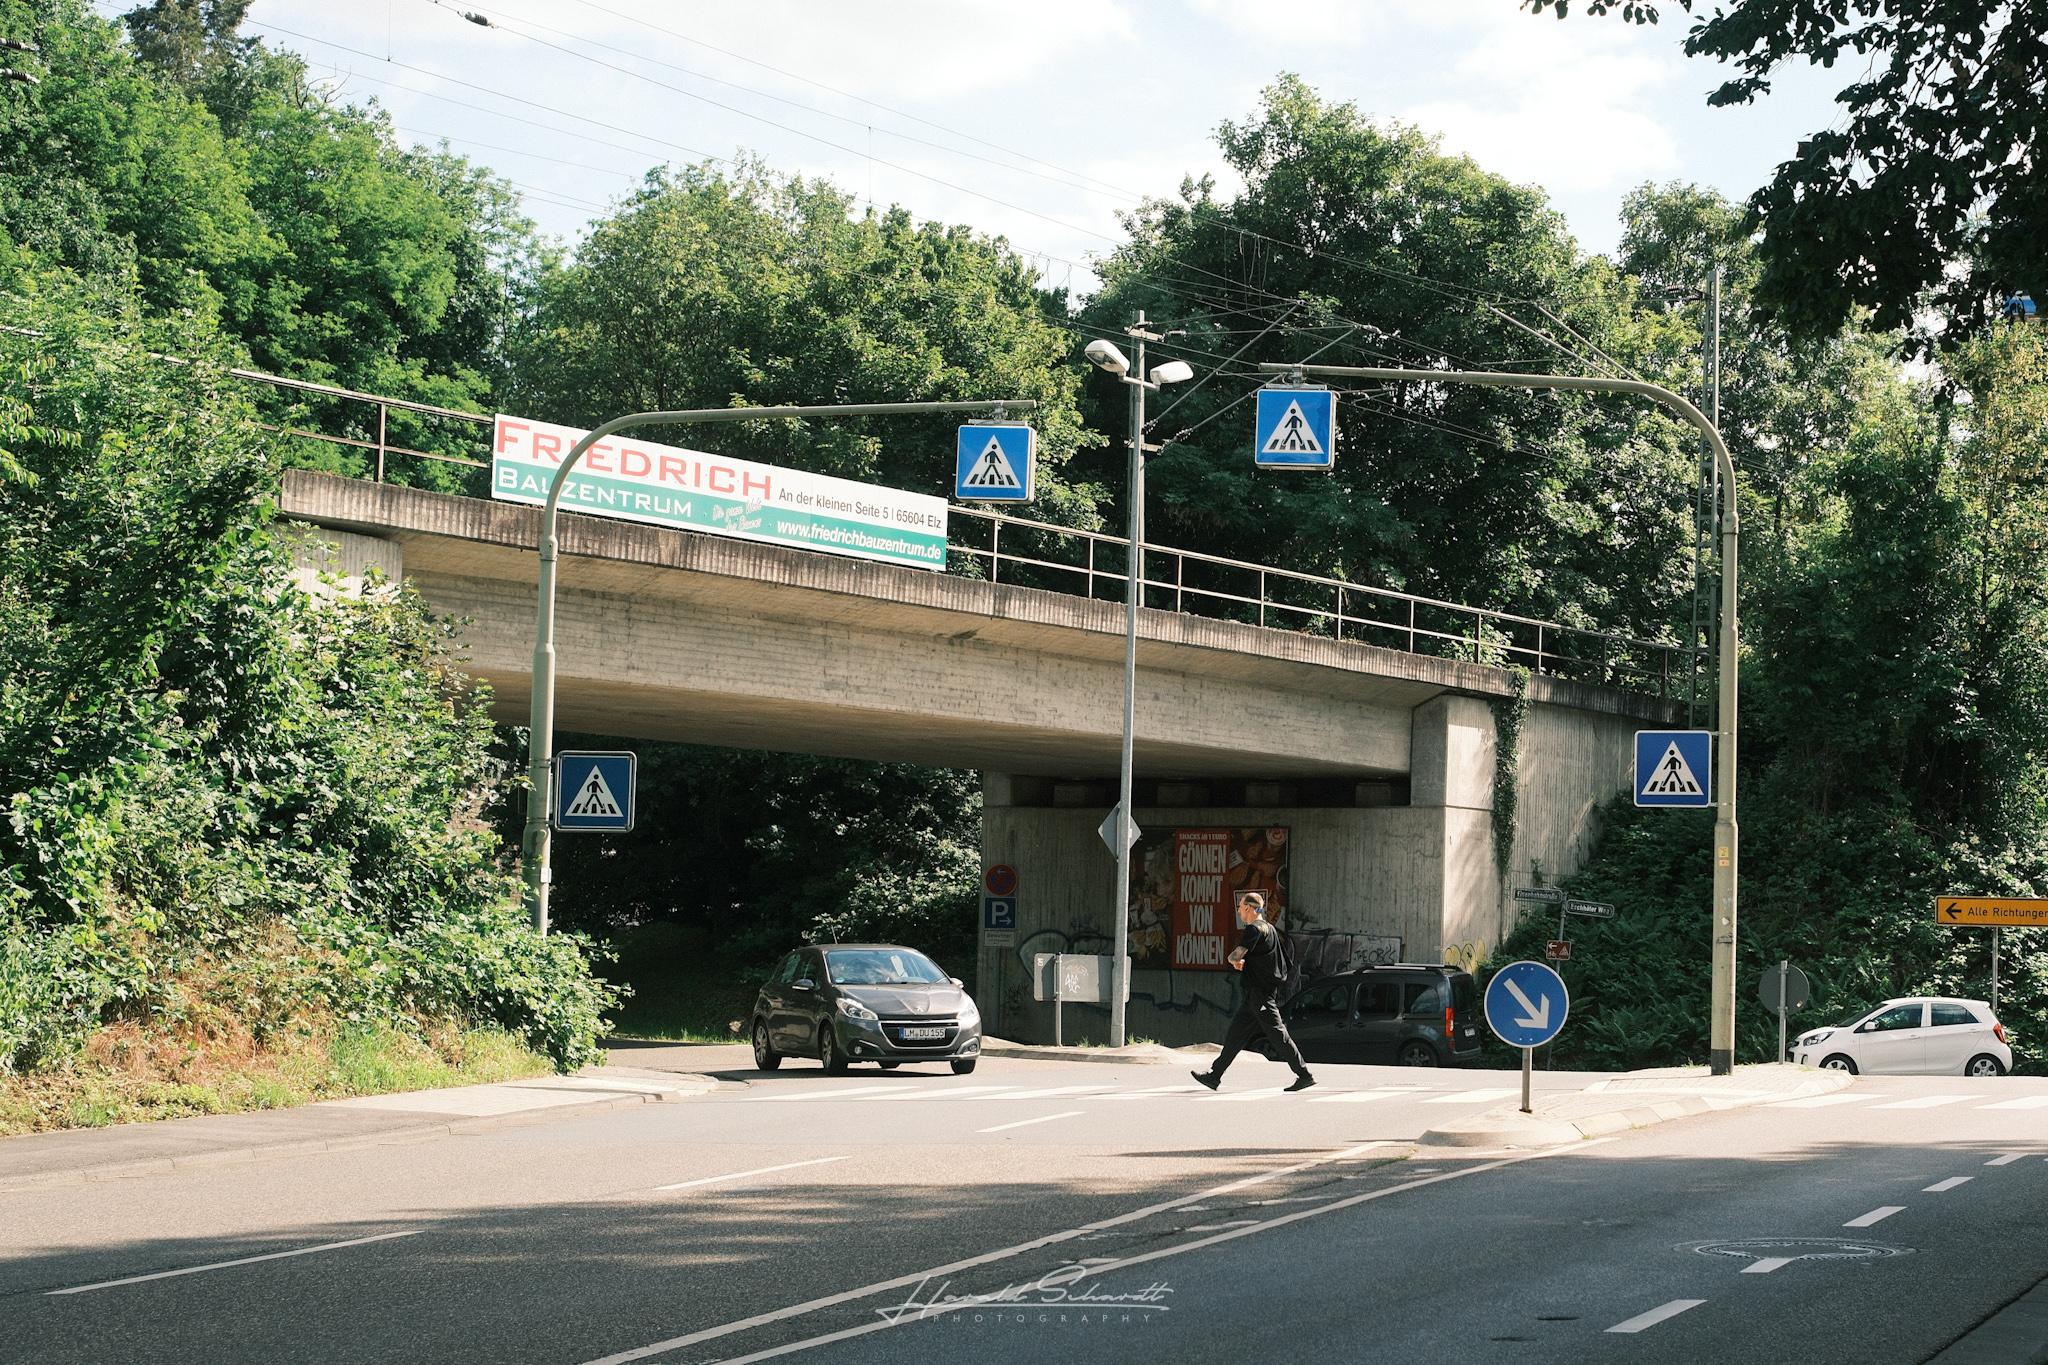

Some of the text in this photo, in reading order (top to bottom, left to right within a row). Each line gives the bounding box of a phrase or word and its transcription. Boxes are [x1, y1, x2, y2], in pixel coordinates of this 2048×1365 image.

[778, 487, 793, 502] An
[796, 491, 813, 506] der
[816, 494, 852, 513] kleinen
[855, 501, 880, 518] Seite
[882, 506, 889, 519] 5
[896, 509, 925, 526] 65604
[927, 514, 942, 529] Elz
[776, 520, 942, 560] www.friedrichbauzentrum.de
[1179, 841, 1226, 874] GÖNNEN
[1180, 874, 1224, 903] KOMMT
[991, 901, 1009, 925] P
[1189, 905, 1214, 934] VON
[1967, 906, 1988, 917] Alle
[1175, 933, 1225, 965] KÖNNEN
